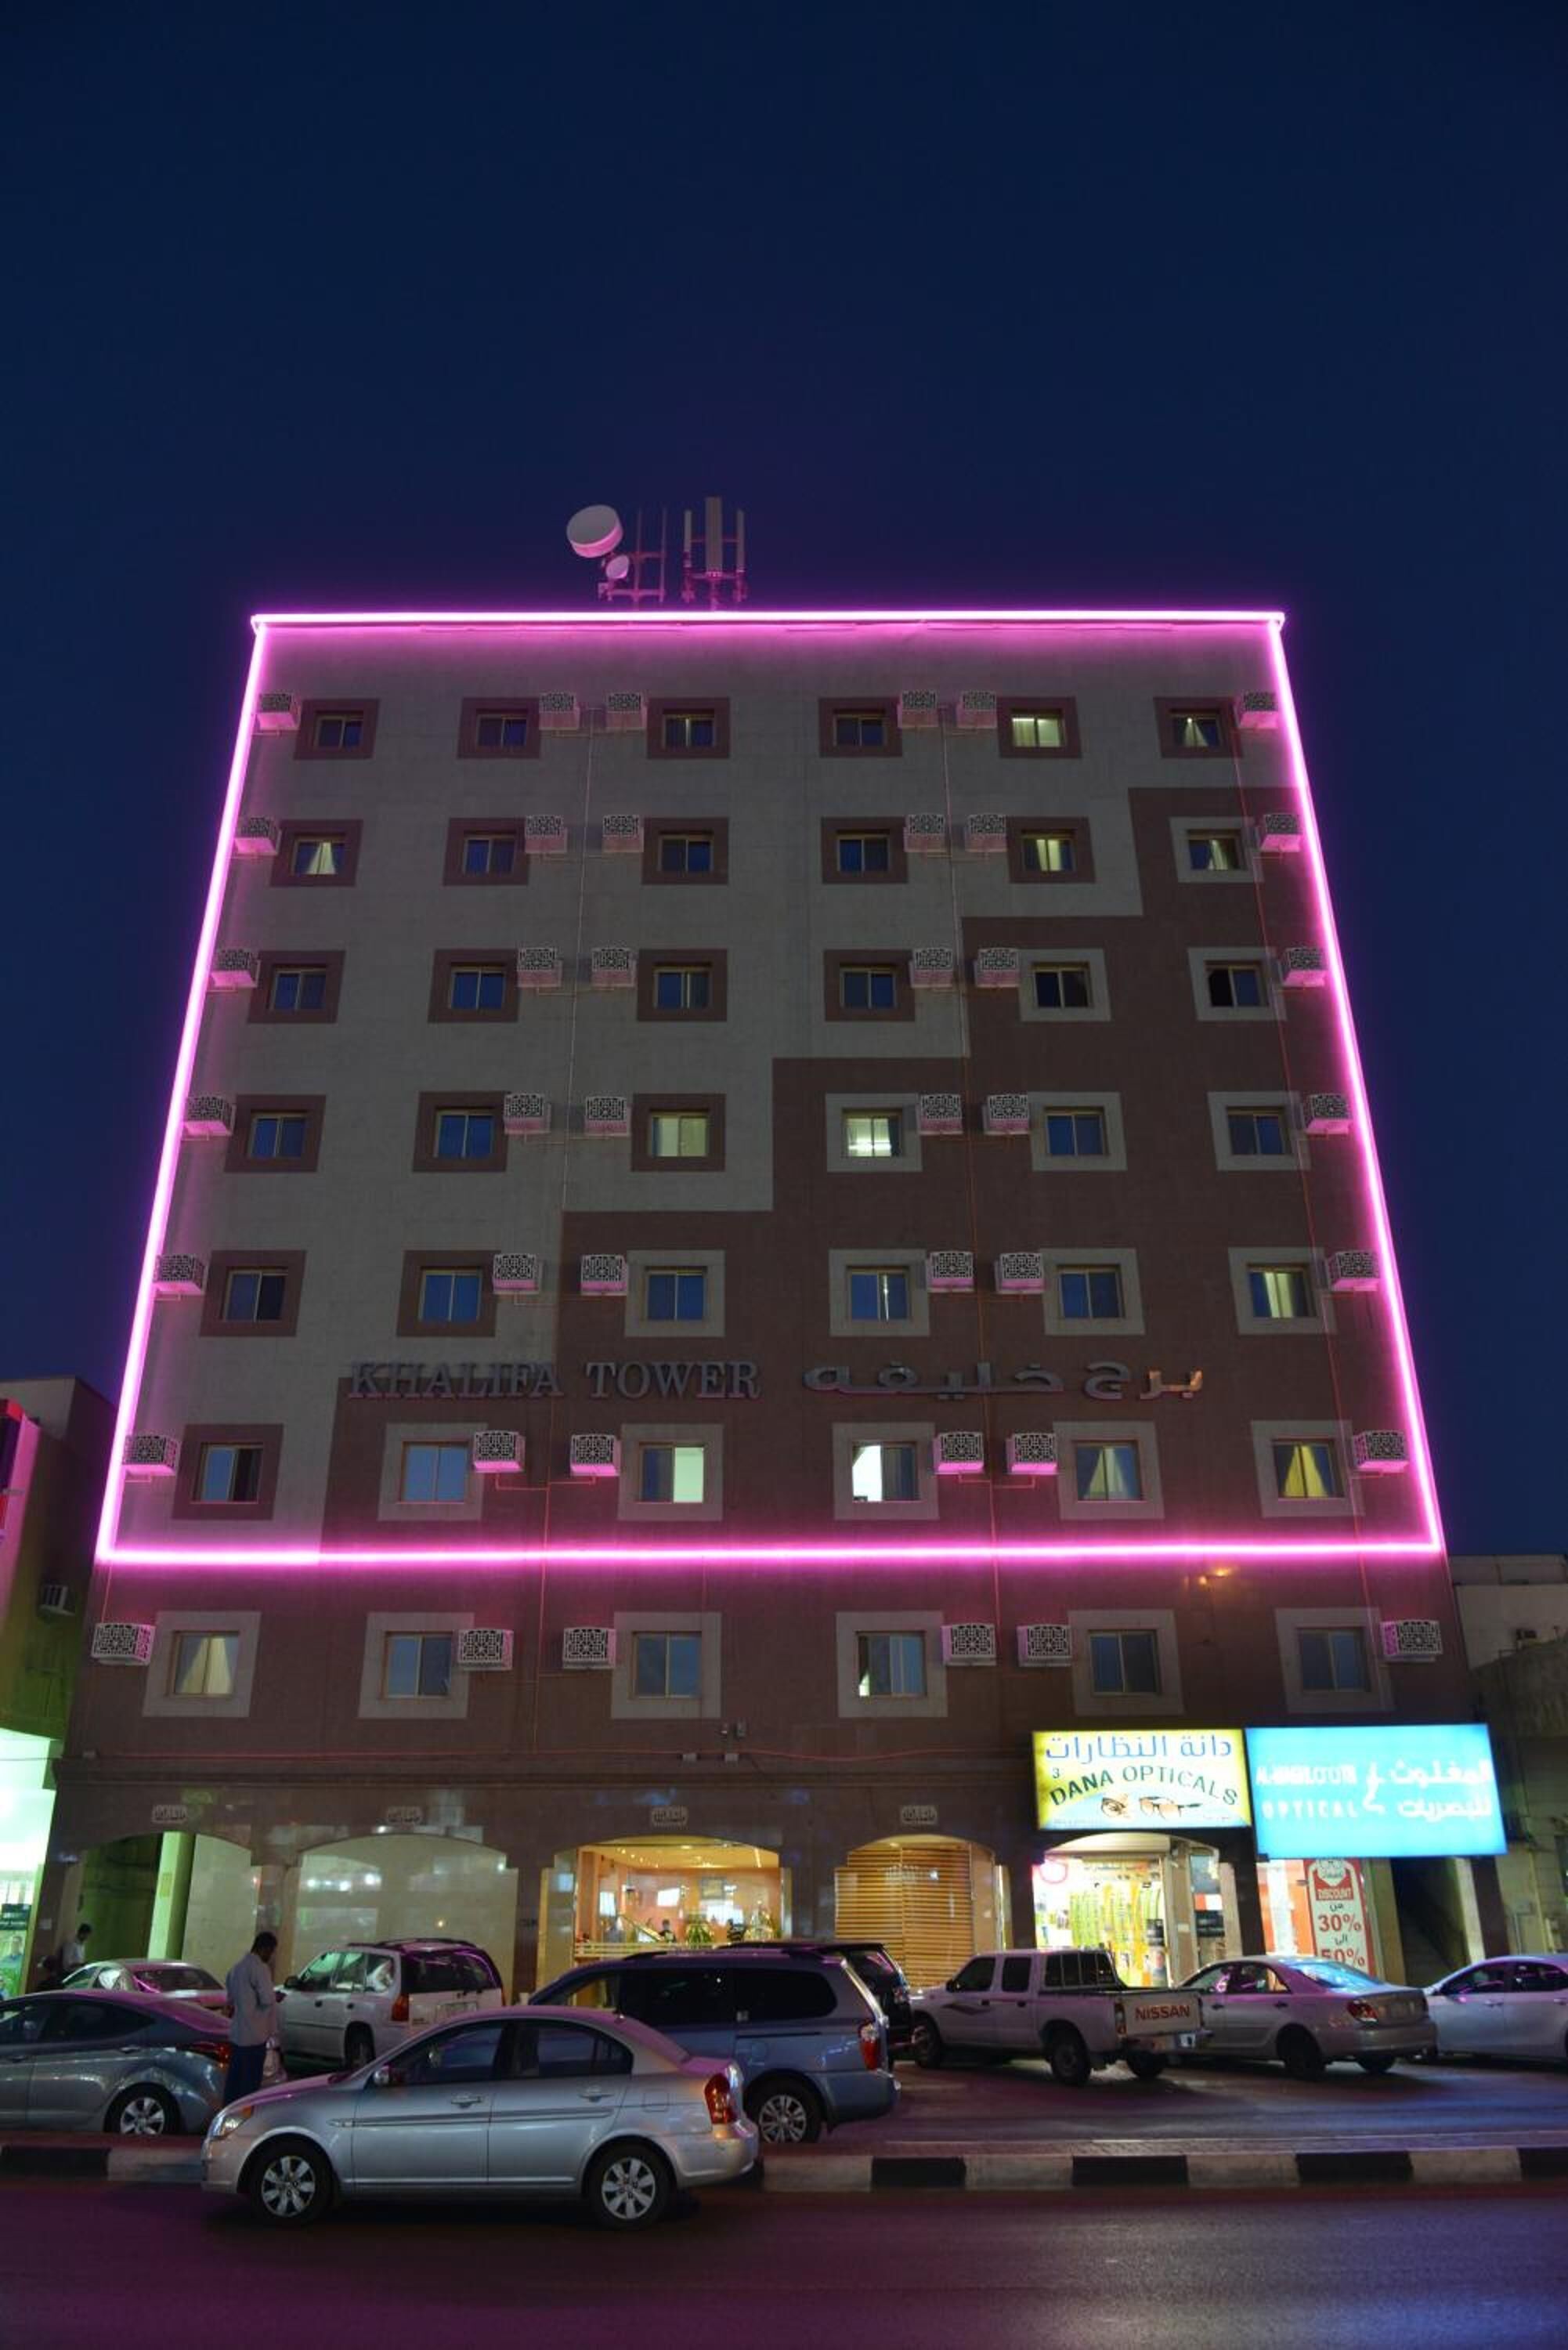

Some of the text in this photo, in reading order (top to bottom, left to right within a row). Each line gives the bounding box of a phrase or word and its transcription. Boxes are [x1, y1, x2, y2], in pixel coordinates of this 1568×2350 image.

[349, 1360, 762, 1400] KHALIFA TOWER
[1082, 1361, 1203, 1400] برج
[1046, 1734, 1232, 1764] دانة النظارات
[1050, 1766, 1238, 1806] DANA OPTICALS
[1262, 1799, 1359, 1819] OPTICAL
[1317, 1888, 1352, 1900] DISCOUNT
[1318, 1914, 1361, 1932] 30%
[1321, 1947, 1365, 1967] 50%
[1134, 2005, 1190, 2019] NISSAN
